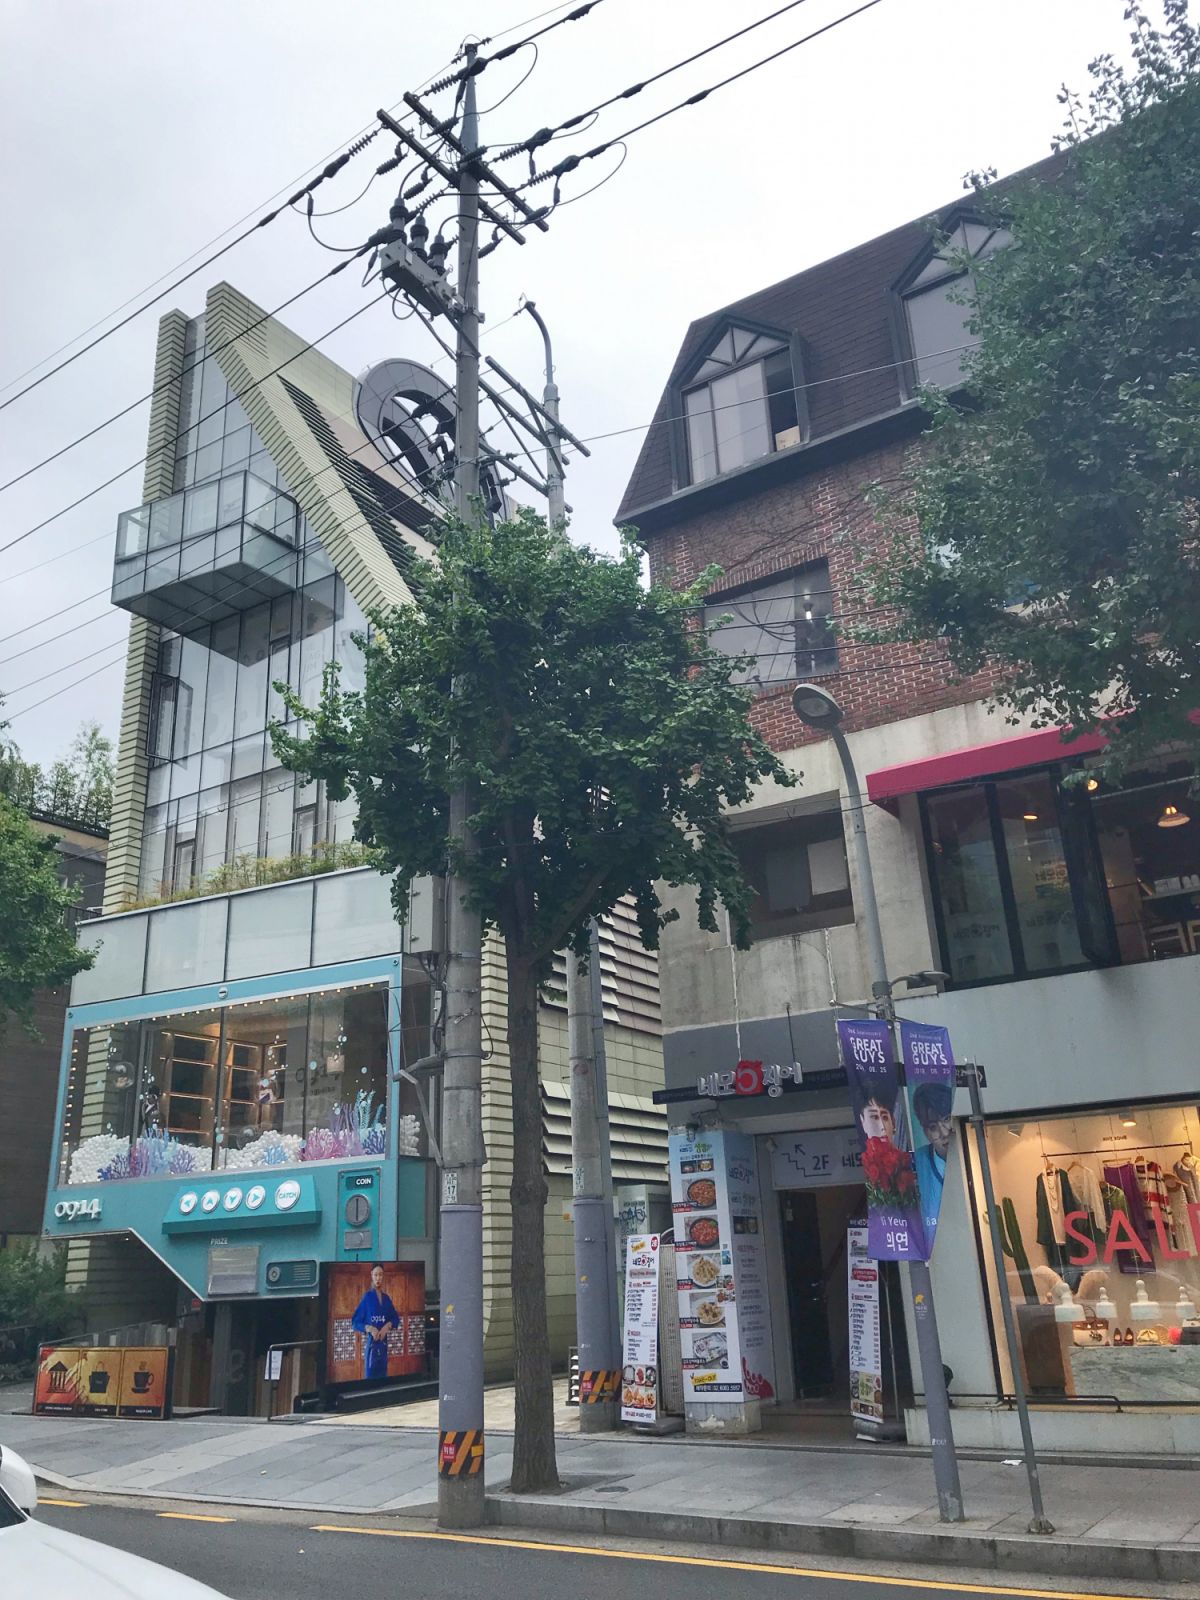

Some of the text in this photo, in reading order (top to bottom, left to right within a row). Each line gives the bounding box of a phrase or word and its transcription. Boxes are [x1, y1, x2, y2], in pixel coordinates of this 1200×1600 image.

[911, 1041, 943, 1055] GREAT
[912, 1053, 948, 1065] GUYS
[812, 1154, 831, 1171] 2F
[355, 1177, 371, 1186] COIN
[278, 1190, 298, 1200] CATCH
[54, 1198, 102, 1221] 0914
[210, 1237, 229, 1245] PRIZE
[886, 1231, 909, 1252] 의연
[370, 1315, 386, 1323] 0914
